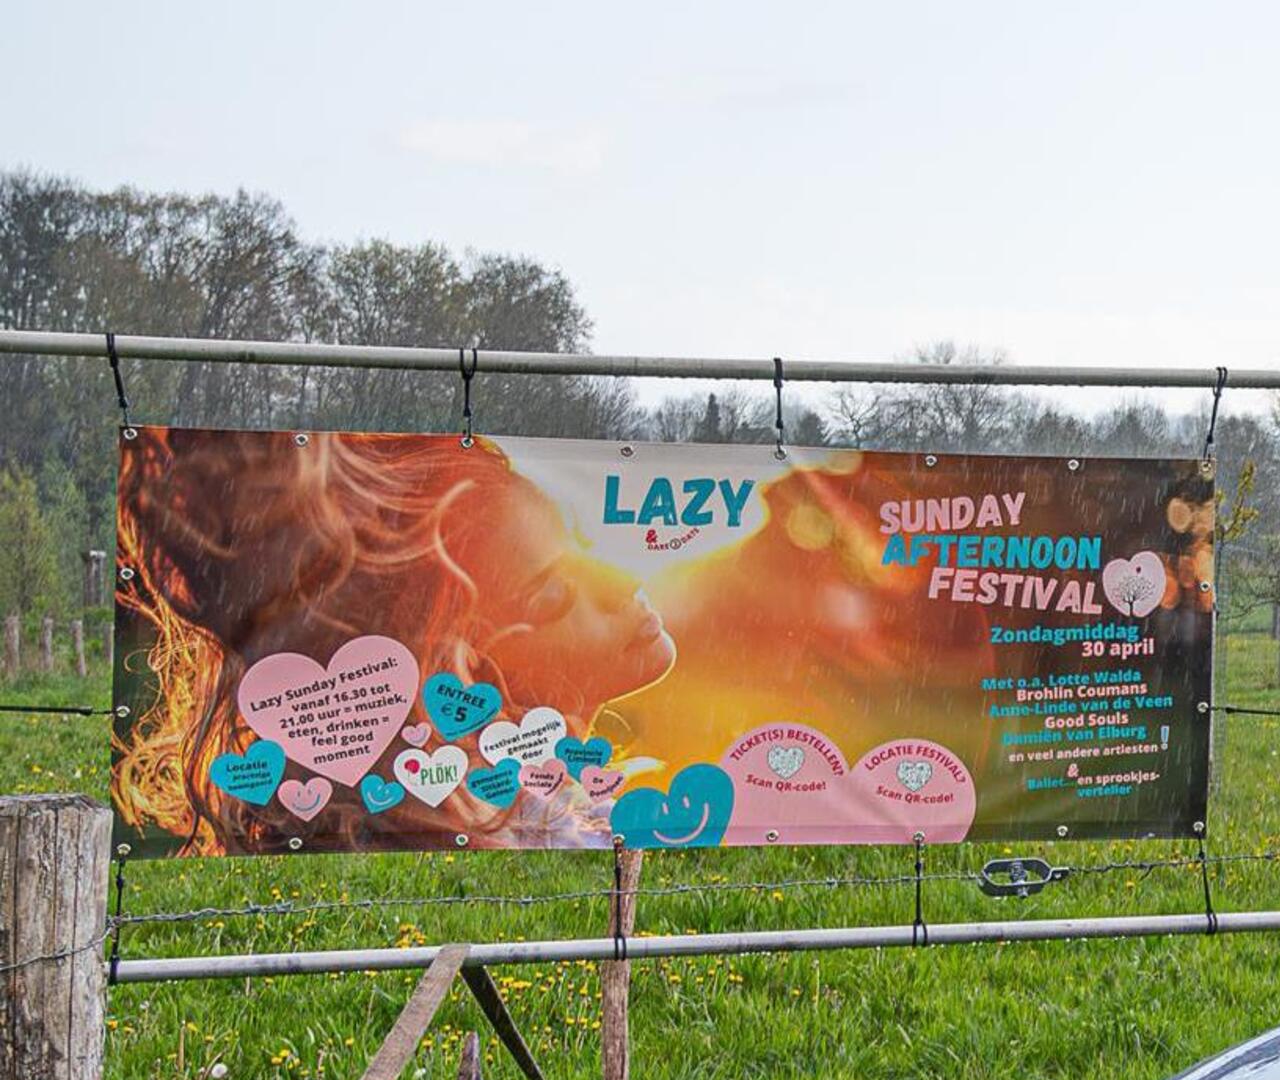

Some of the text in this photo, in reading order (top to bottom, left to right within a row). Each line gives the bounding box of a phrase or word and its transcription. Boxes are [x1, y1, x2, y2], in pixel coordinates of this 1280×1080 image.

[603, 475, 756, 527] LAZY
[879, 492, 1026, 534] SUNDAY
[645, 529, 658, 543] &
[881, 534, 1102, 570] AFTERNOON
[928, 567, 1103, 615] FESTIVAL
[990, 624, 1140, 645] Zondagmiddag
[1081, 639, 1155, 659] 30 april
[250, 657, 398, 712] Lazy Sunday Festival:
[982, 669, 1142, 691] Met o.a. Lotte Walda
[292, 683, 390, 712] vanaf 16.30 tot
[437, 684, 487, 709] ENTREE
[1016, 683, 1147, 702] Brohlin Coumans
[280, 713, 314, 729] 21.00
[318, 707, 340, 719] uur
[355, 694, 407, 713] muziek,
[989, 695, 1173, 717] Anne-Linde van de Veen
[288, 724, 323, 738] eten,
[327, 717, 378, 732] drinken
[522, 721, 561, 740] mogelijk
[1044, 712, 1129, 729] Good Souls
[311, 731, 374, 747] feel good
[1066, 729, 1094, 741] van
[314, 746, 370, 764] moment
[507, 736, 549, 755] gemaakt
[522, 748, 543, 760] door
[729, 729, 844, 777] TICKET(S) BESTELLEN?
[1008, 752, 1024, 762] en
[1027, 749, 1054, 761] veel
[1056, 746, 1099, 759] andere
[1102, 742, 1158, 756] artiesten
[226, 761, 268, 772] Locatie
[420, 763, 458, 785] PLÖK!
[865, 744, 966, 784] LOCATIE FESTIVAL?
[1067, 763, 1079, 777] &
[745, 774, 827, 792] Scan QR-code!
[1077, 775, 1093, 785] en
[1096, 770, 1160, 787] sprookjes-
[876, 785, 954, 804] Scan QR-code!
